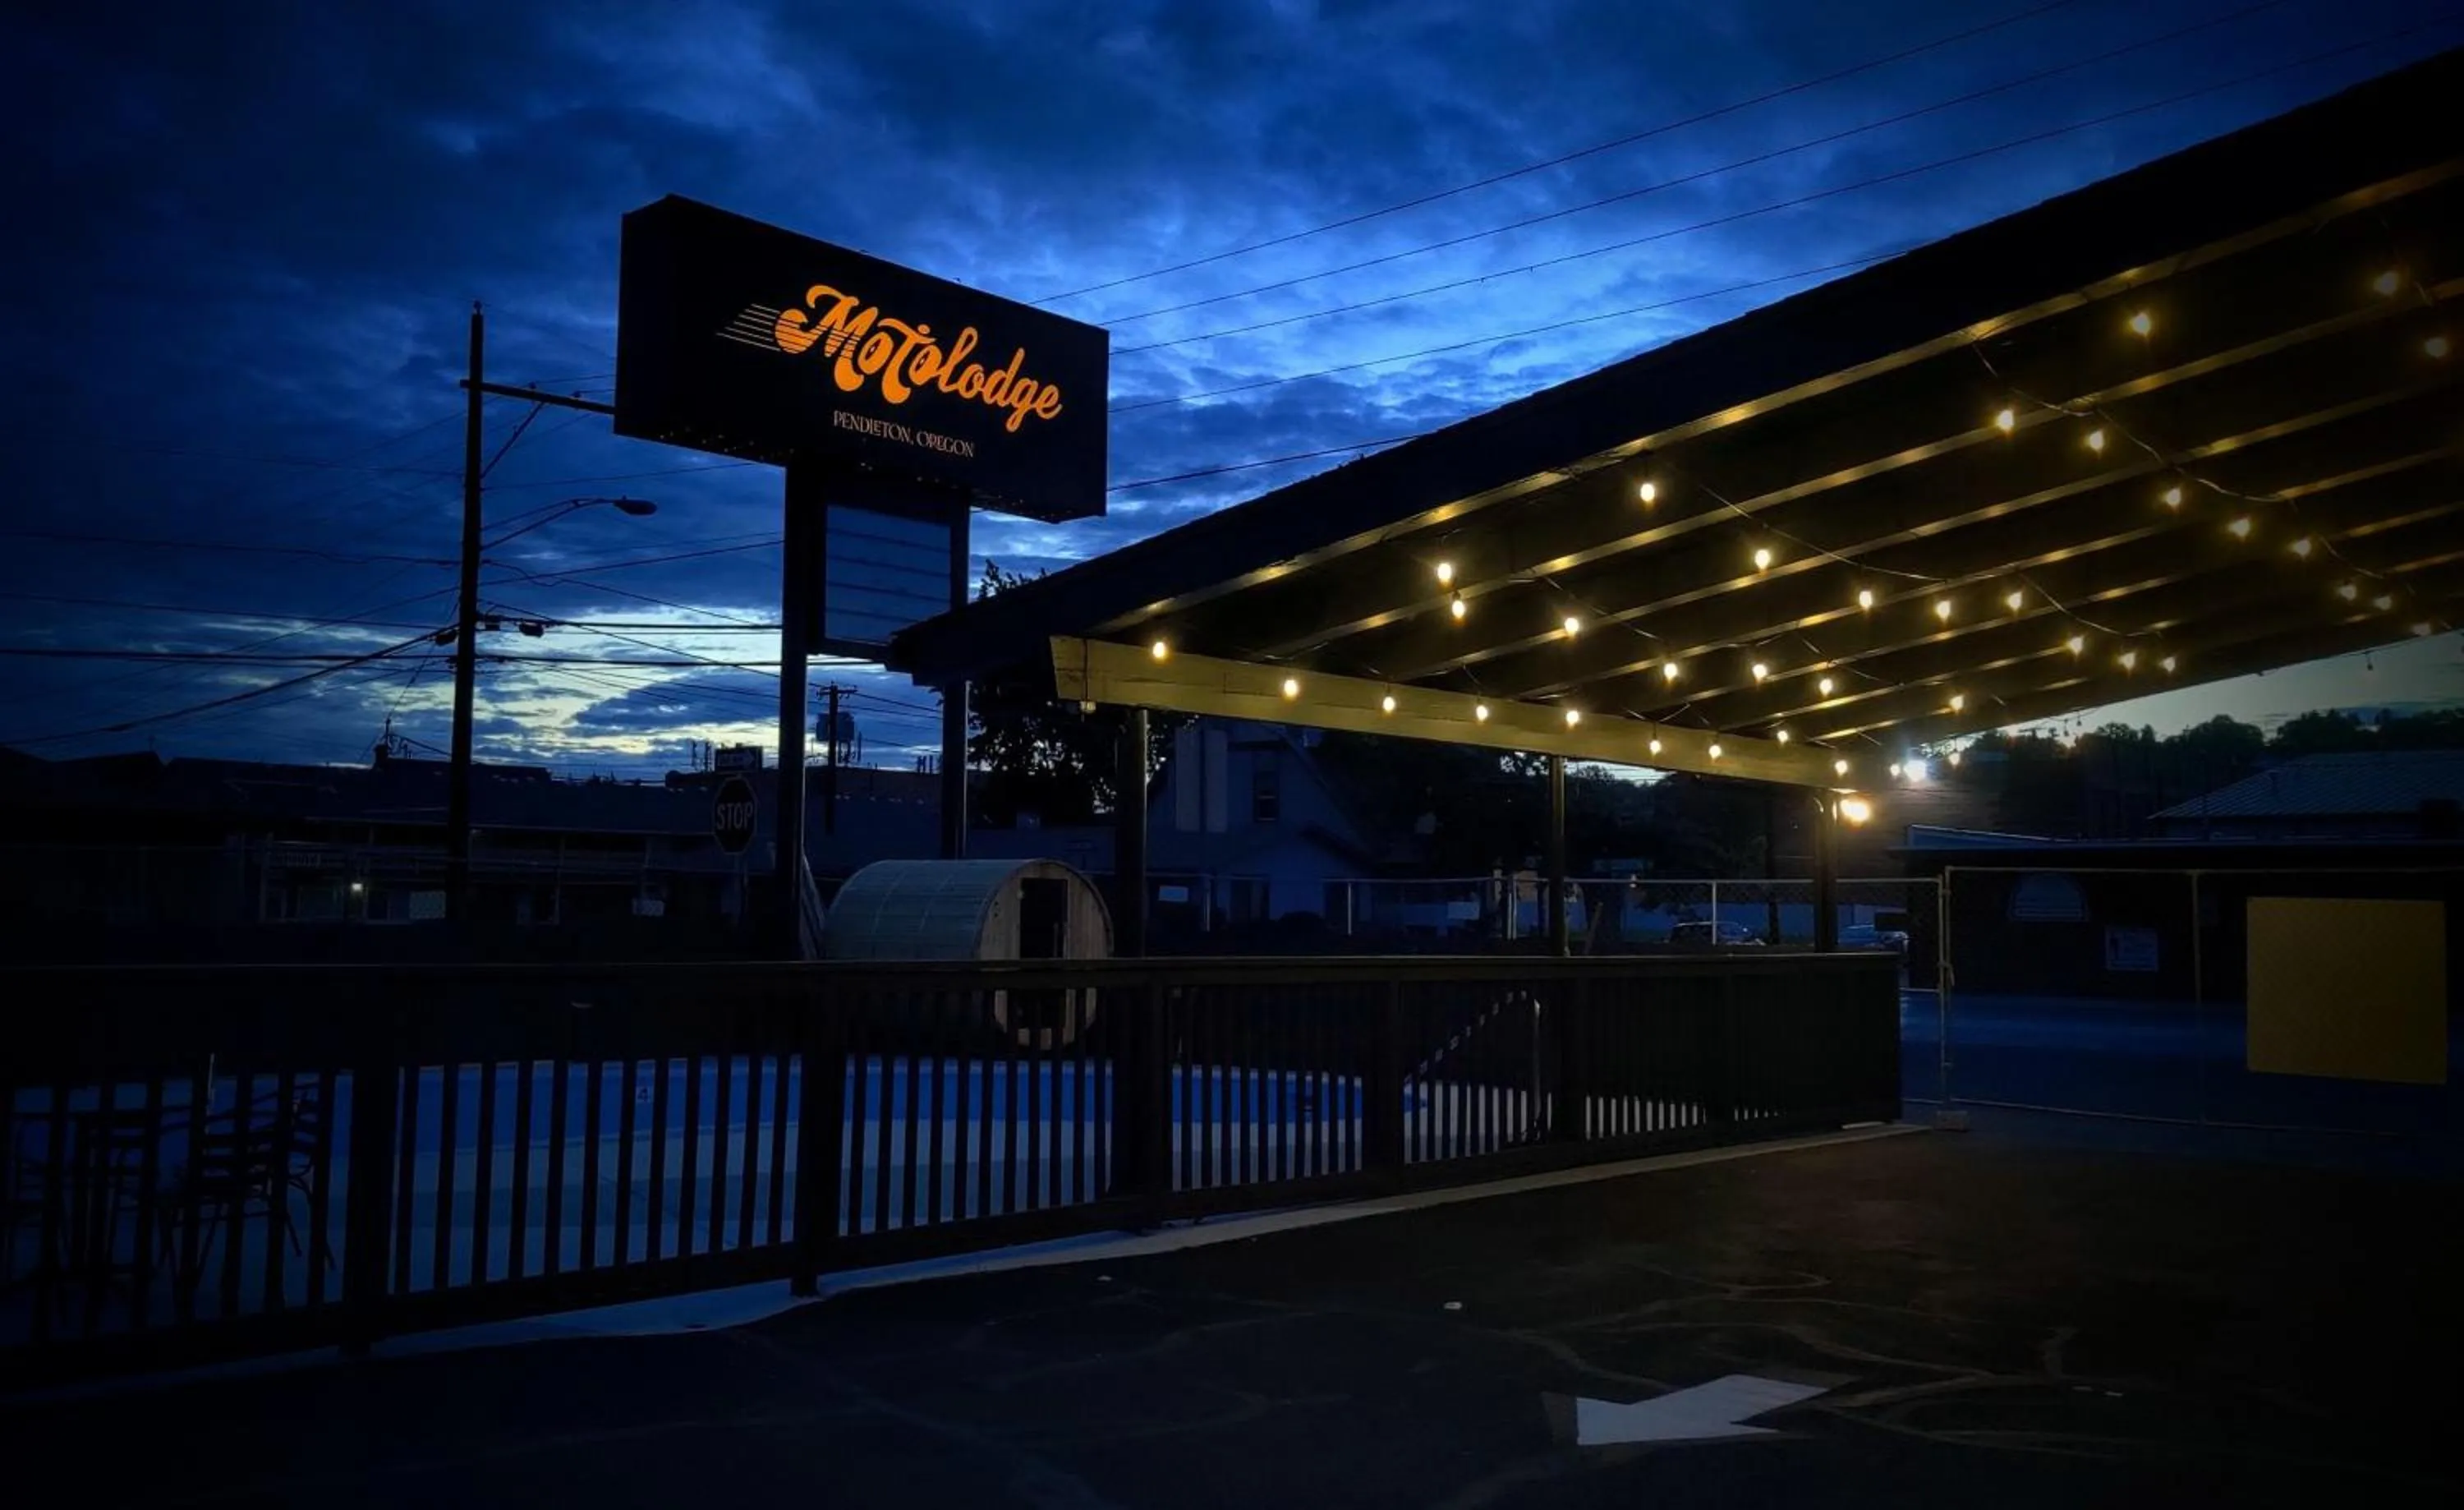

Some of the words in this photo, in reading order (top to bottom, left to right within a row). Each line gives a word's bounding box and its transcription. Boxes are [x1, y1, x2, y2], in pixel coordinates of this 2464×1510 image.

[832, 409, 914, 445] PENDLETON,
[916, 430, 975, 458] OREGON
[716, 801, 753, 831] STOP
